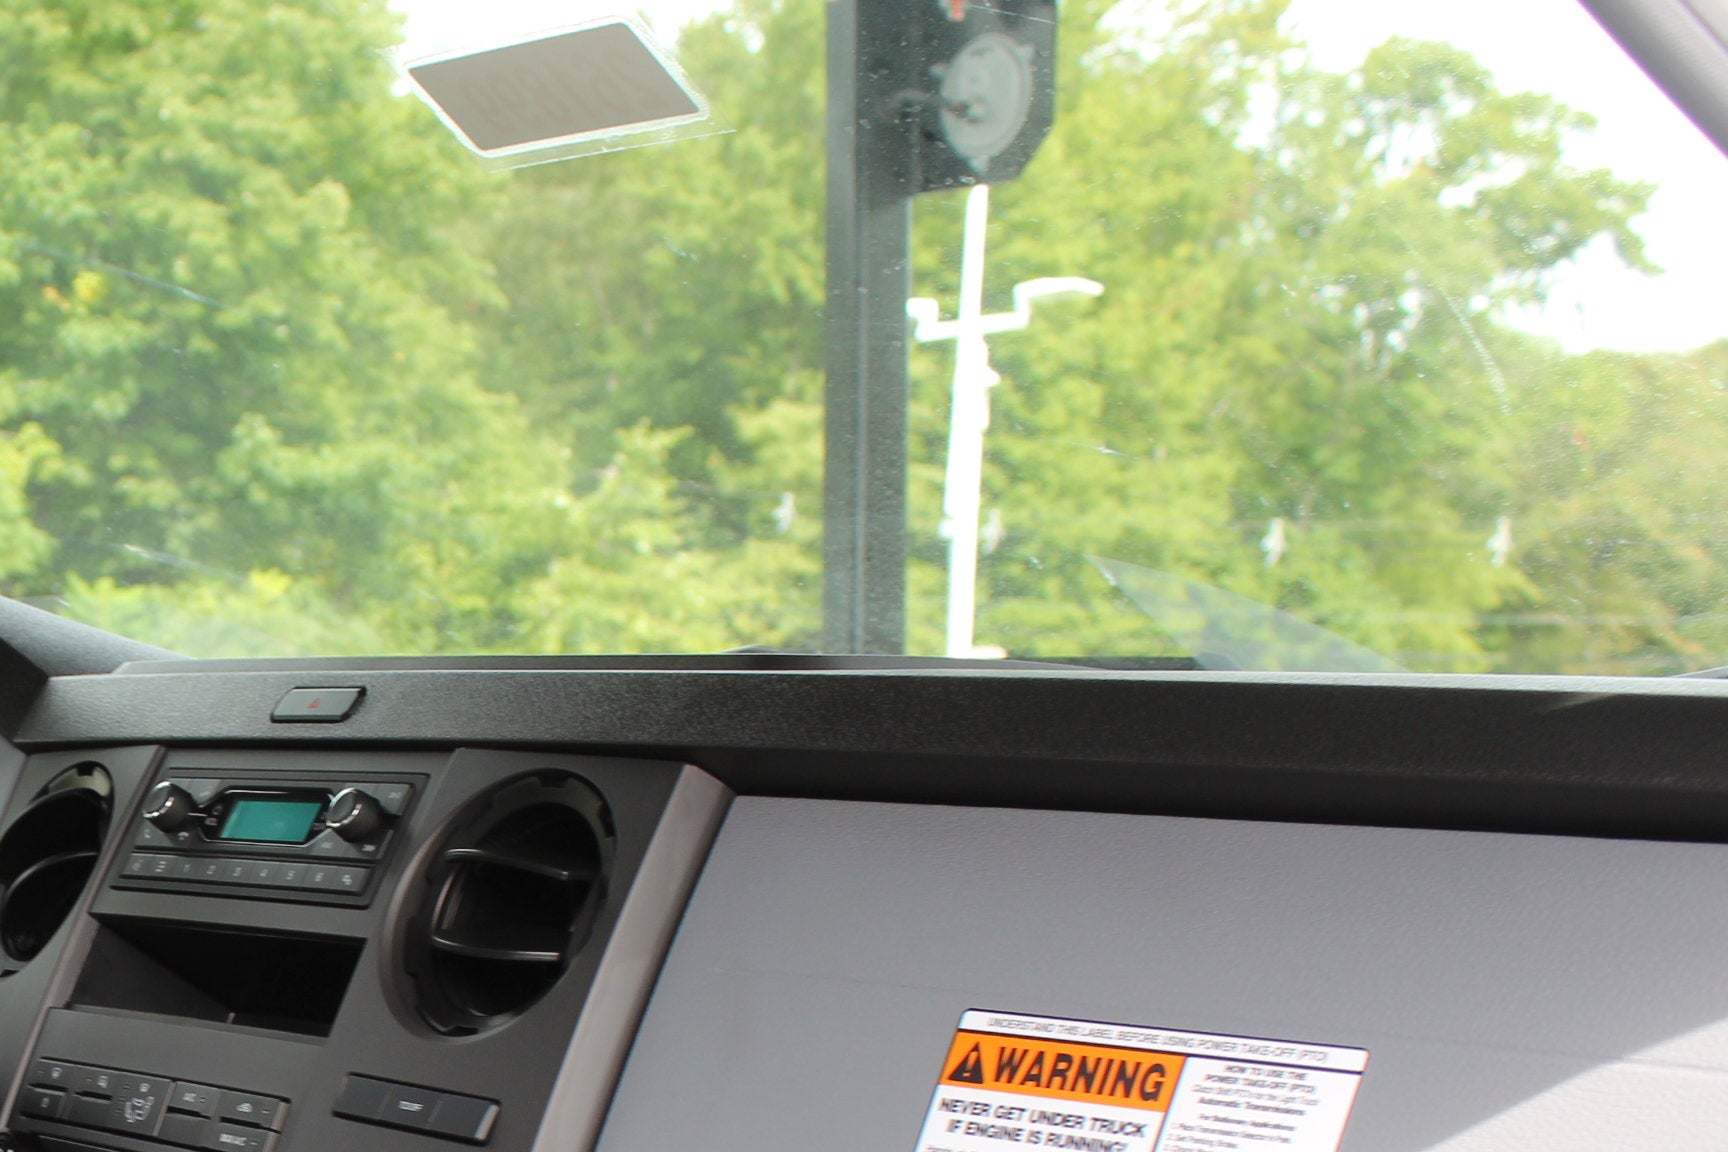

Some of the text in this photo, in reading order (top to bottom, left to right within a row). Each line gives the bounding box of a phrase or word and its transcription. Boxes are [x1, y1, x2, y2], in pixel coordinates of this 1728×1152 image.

[994, 1046, 1168, 1102] WARNING
[936, 1097, 993, 1117] NEVER
[991, 1104, 1027, 1122] GET
[1026, 1108, 1087, 1130] UNDER
[1086, 1116, 1149, 1139] TRUCK
[944, 1118, 964, 1134] IF
[962, 1120, 1025, 1142] ENGINE
[1023, 1129, 1045, 1145] IS
